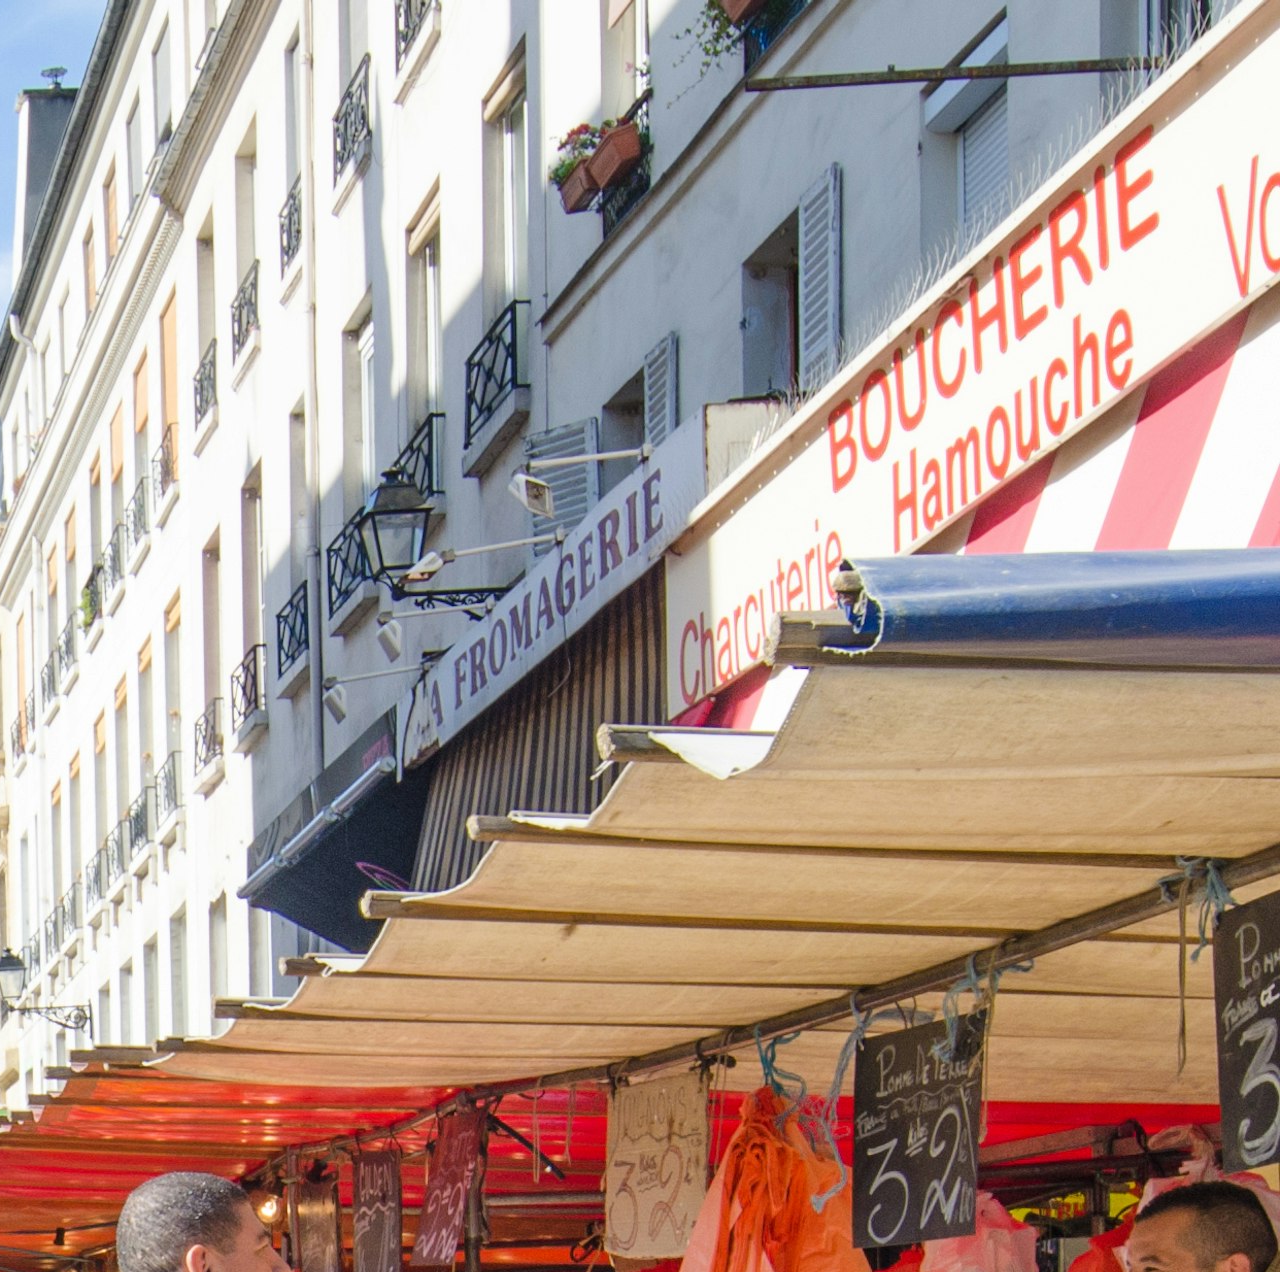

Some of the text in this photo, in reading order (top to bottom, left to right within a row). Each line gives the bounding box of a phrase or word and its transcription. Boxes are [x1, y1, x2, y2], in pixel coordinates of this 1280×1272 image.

[828, 125, 1160, 493] BOUCHERIE
[892, 308, 1134, 552] Hamouche
[453, 468, 664, 711] FROMAGERIE
[680, 518, 843, 706] Charcuterie
[1238, 1016, 1280, 1166] 3
[608, 1159, 639, 1251] 3
[867, 1137, 909, 1245] 3
